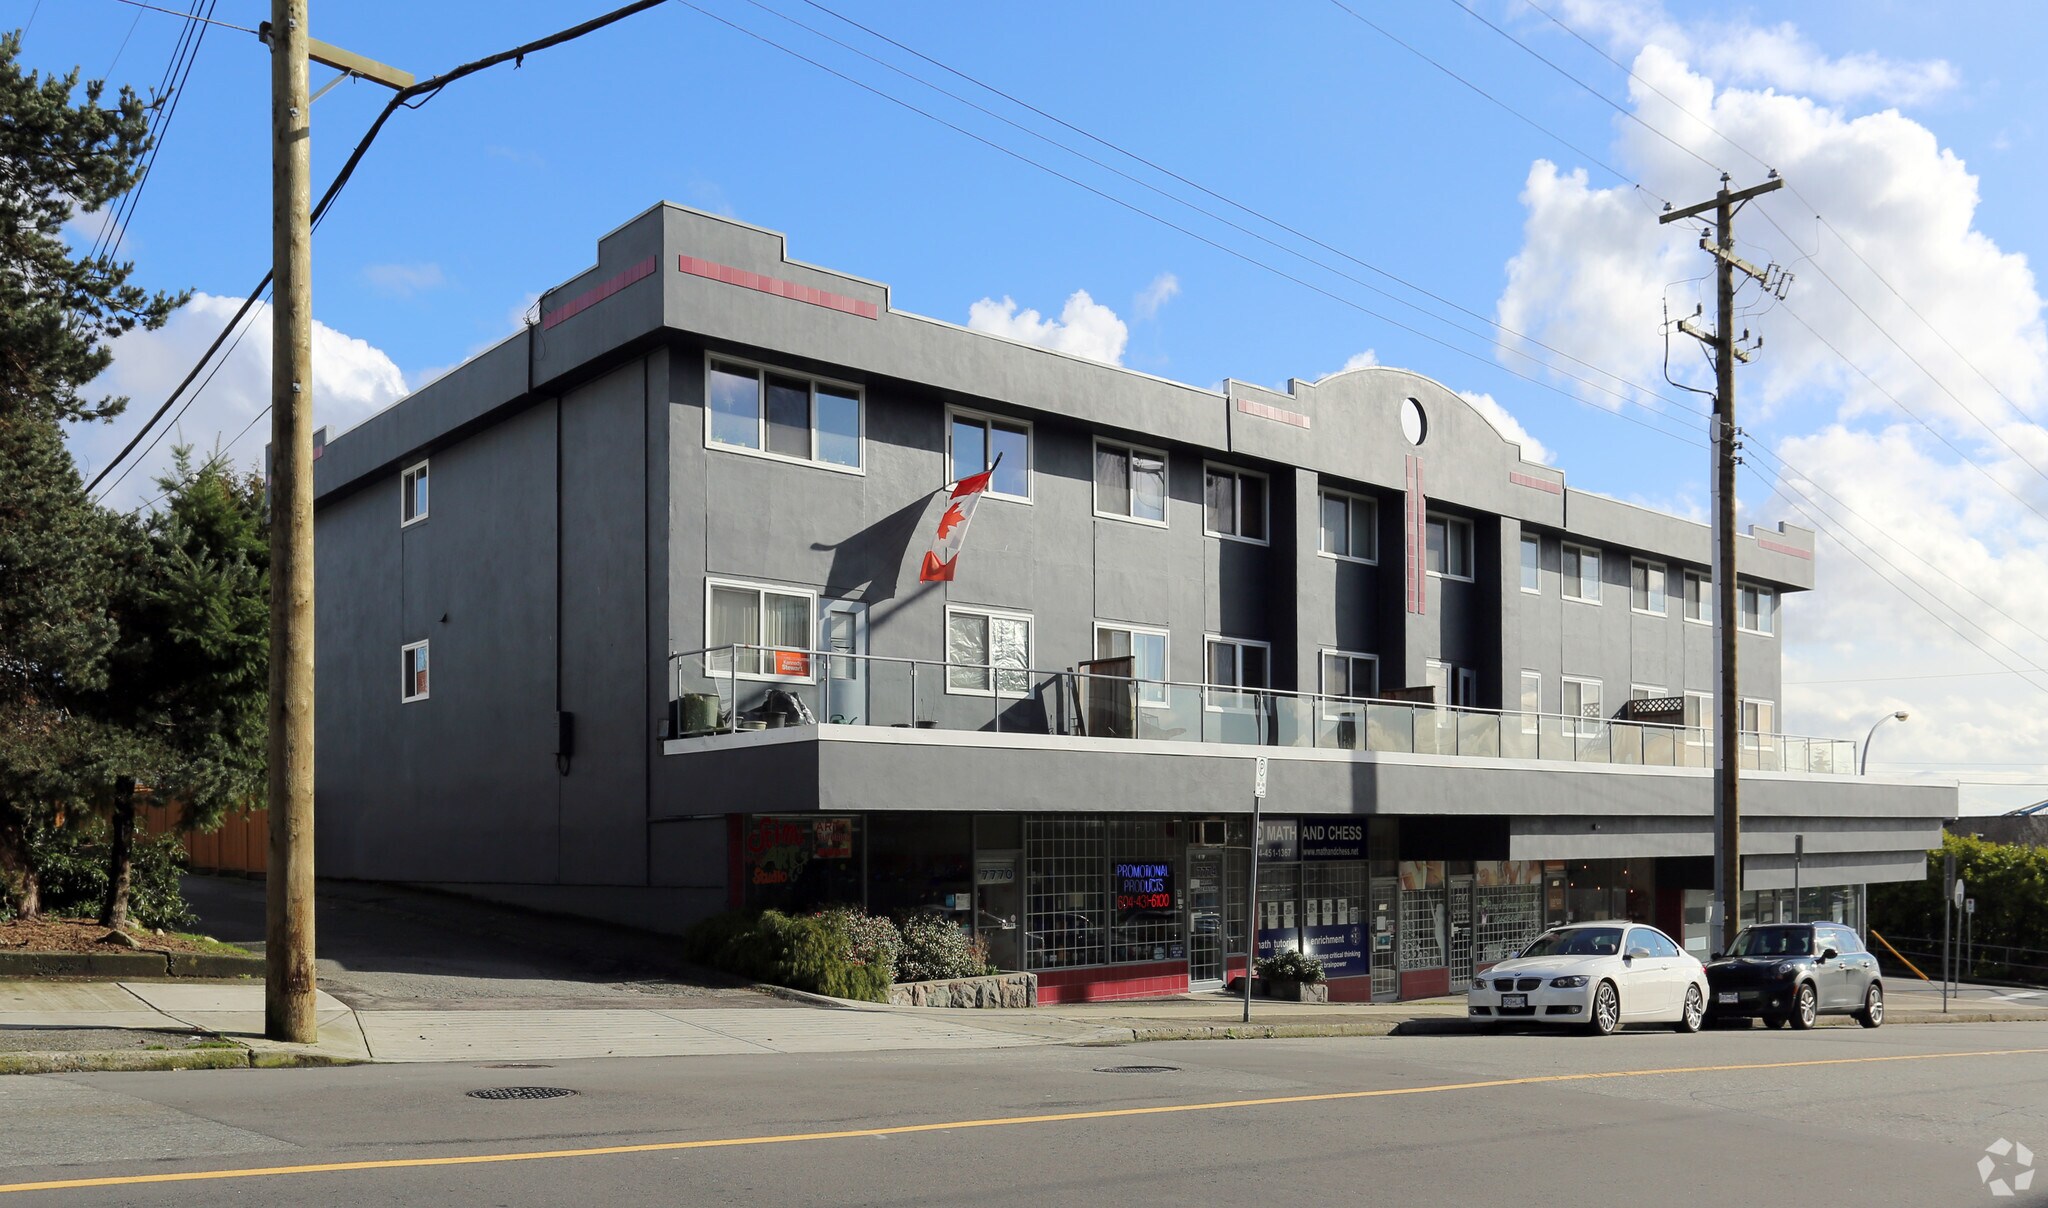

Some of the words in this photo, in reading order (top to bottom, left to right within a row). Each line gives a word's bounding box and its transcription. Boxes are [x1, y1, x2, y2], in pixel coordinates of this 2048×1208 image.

[1267, 826, 1297, 841] MATH
[1302, 825, 1325, 840] AND
[1328, 825, 1362, 841] CHESS
[1302, 847, 1360, 857] www.mathandchess.net
[982, 869, 1012, 880] 7770
[1117, 864, 1170, 878] PROMOTIONAL
[1123, 878, 1164, 893] PRODUCTS
[1117, 893, 1170, 910] 604-431-6100
[1310, 934, 1345, 946] enrichment
[1344, 949, 1361, 958] thinking
